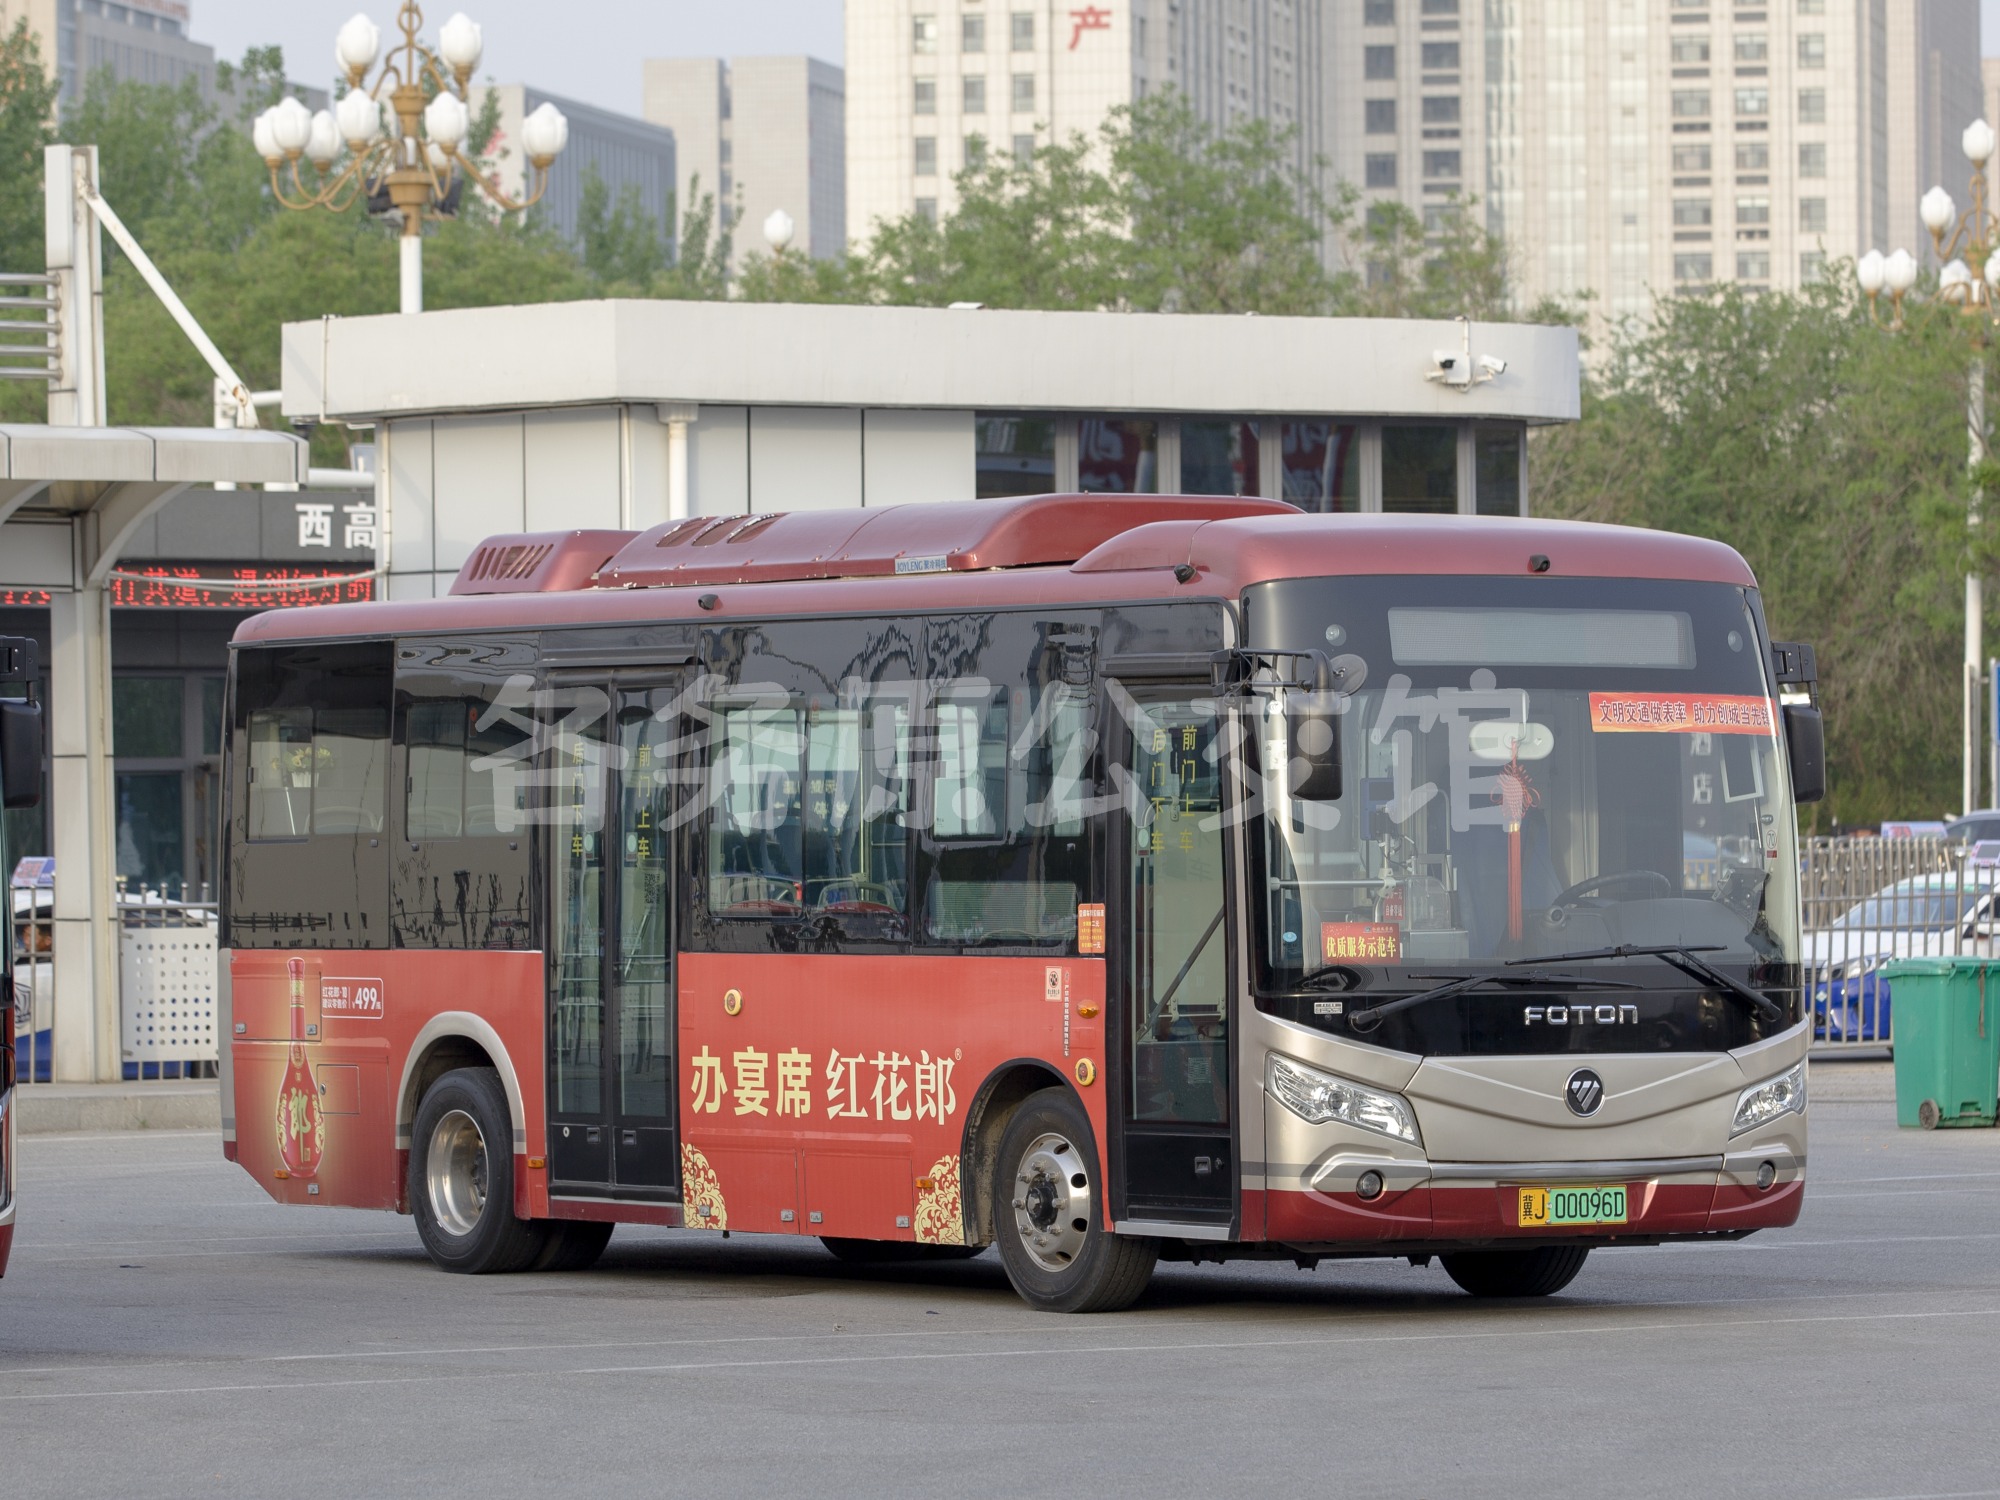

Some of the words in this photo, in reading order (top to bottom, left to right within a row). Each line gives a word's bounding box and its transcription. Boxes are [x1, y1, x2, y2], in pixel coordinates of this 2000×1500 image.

[1069, 6, 1111, 51] 产
[296, 502, 375, 549] 西高
[1599, 701, 1687, 724] 文明交通做表率
[572, 742, 584, 857] 后门下车
[637, 744, 651, 860] 前门上车
[1151, 728, 1167, 856] 后门下车
[1179, 725, 1197, 853] 前门上车
[1327, 935, 1397, 958] 优质服务示范车
[1524, 1004, 1639, 1026] FOTON
[691, 1045, 812, 1118] 办宴席
[825, 1048, 956, 1125] 红花郎
